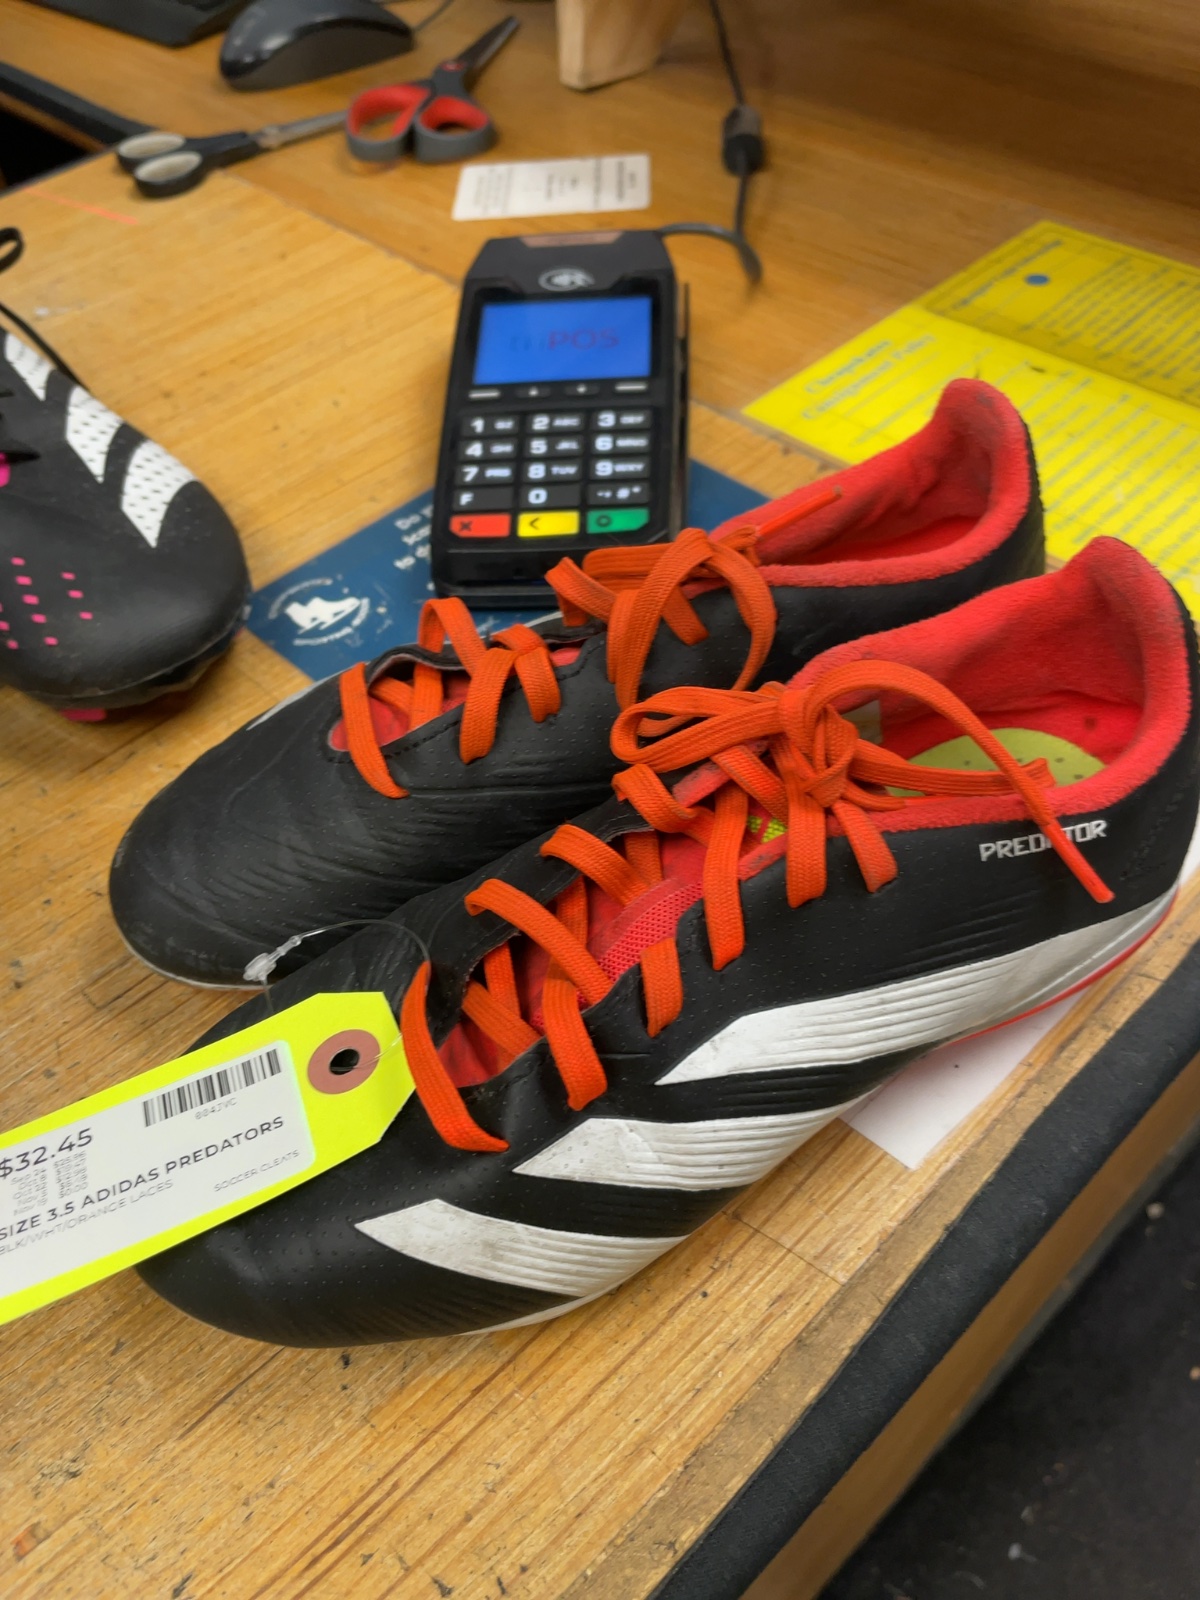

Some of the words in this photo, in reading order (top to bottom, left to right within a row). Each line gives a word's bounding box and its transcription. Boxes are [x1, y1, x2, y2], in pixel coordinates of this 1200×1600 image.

[470, 417, 485, 434] 1
[532, 414, 549, 431] 2
[597, 411, 616, 428] 3
[465, 442, 483, 457] 4
[530, 439, 548, 455] 5
[595, 435, 614, 452] 6
[462, 465, 479, 482] 7
[528, 462, 546, 480] 8
[595, 460, 614, 476] 9
[460, 492, 474, 506] F
[978, 819, 1107, 862] PREDTOR
[0, 1127, 93, 1180] $32.45
[0, 1214, 41, 1241] SIZE
[47, 1201, 75, 1222] 3.5
[81, 1167, 160, 1209] ADIDAS
[165, 1116, 284, 1174] PREDATORS
[213, 1168, 259, 1193] SOCCER
[260, 1149, 300, 1173] CLEATS
[130, 1179, 174, 1204] LACES
